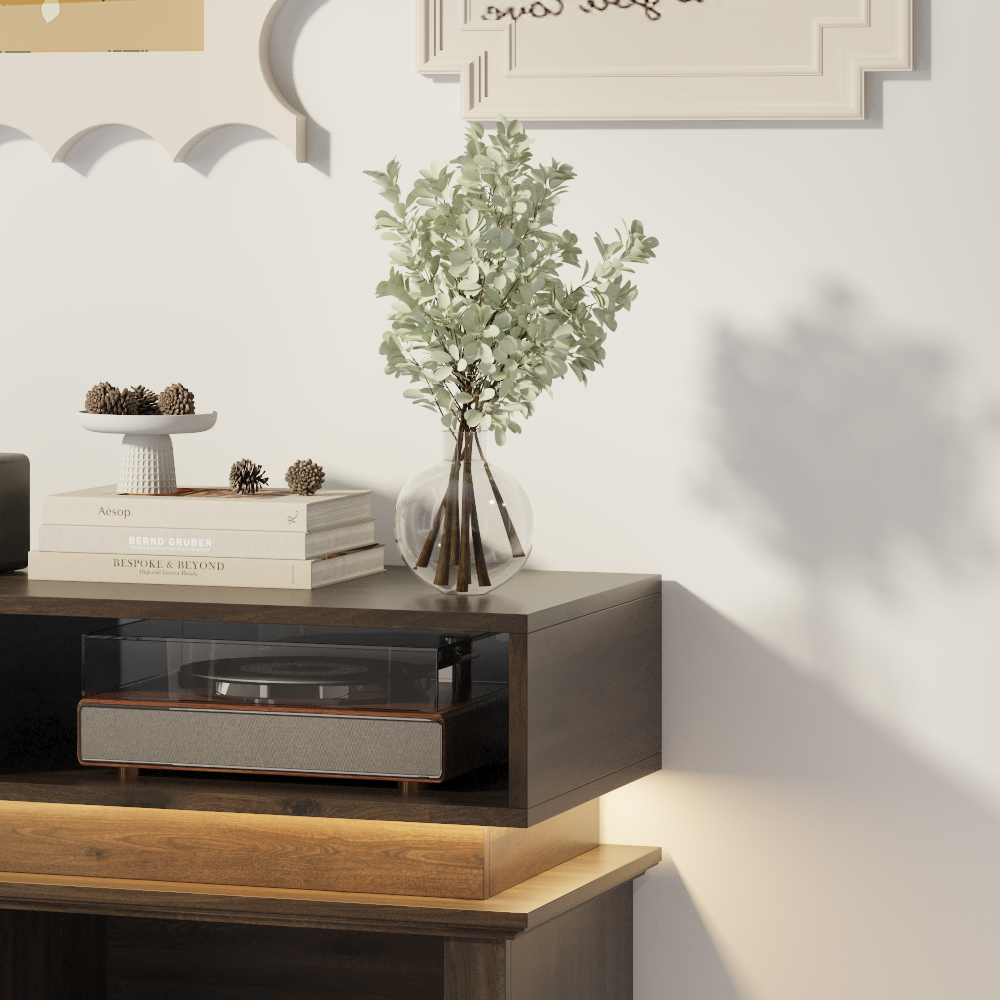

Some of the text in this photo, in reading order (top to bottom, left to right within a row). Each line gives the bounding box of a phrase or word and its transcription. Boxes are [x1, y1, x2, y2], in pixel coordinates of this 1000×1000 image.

[128, 536, 212, 548] BERND GRUBER
[113, 558, 225, 571] BESPOKE & BEYOND
